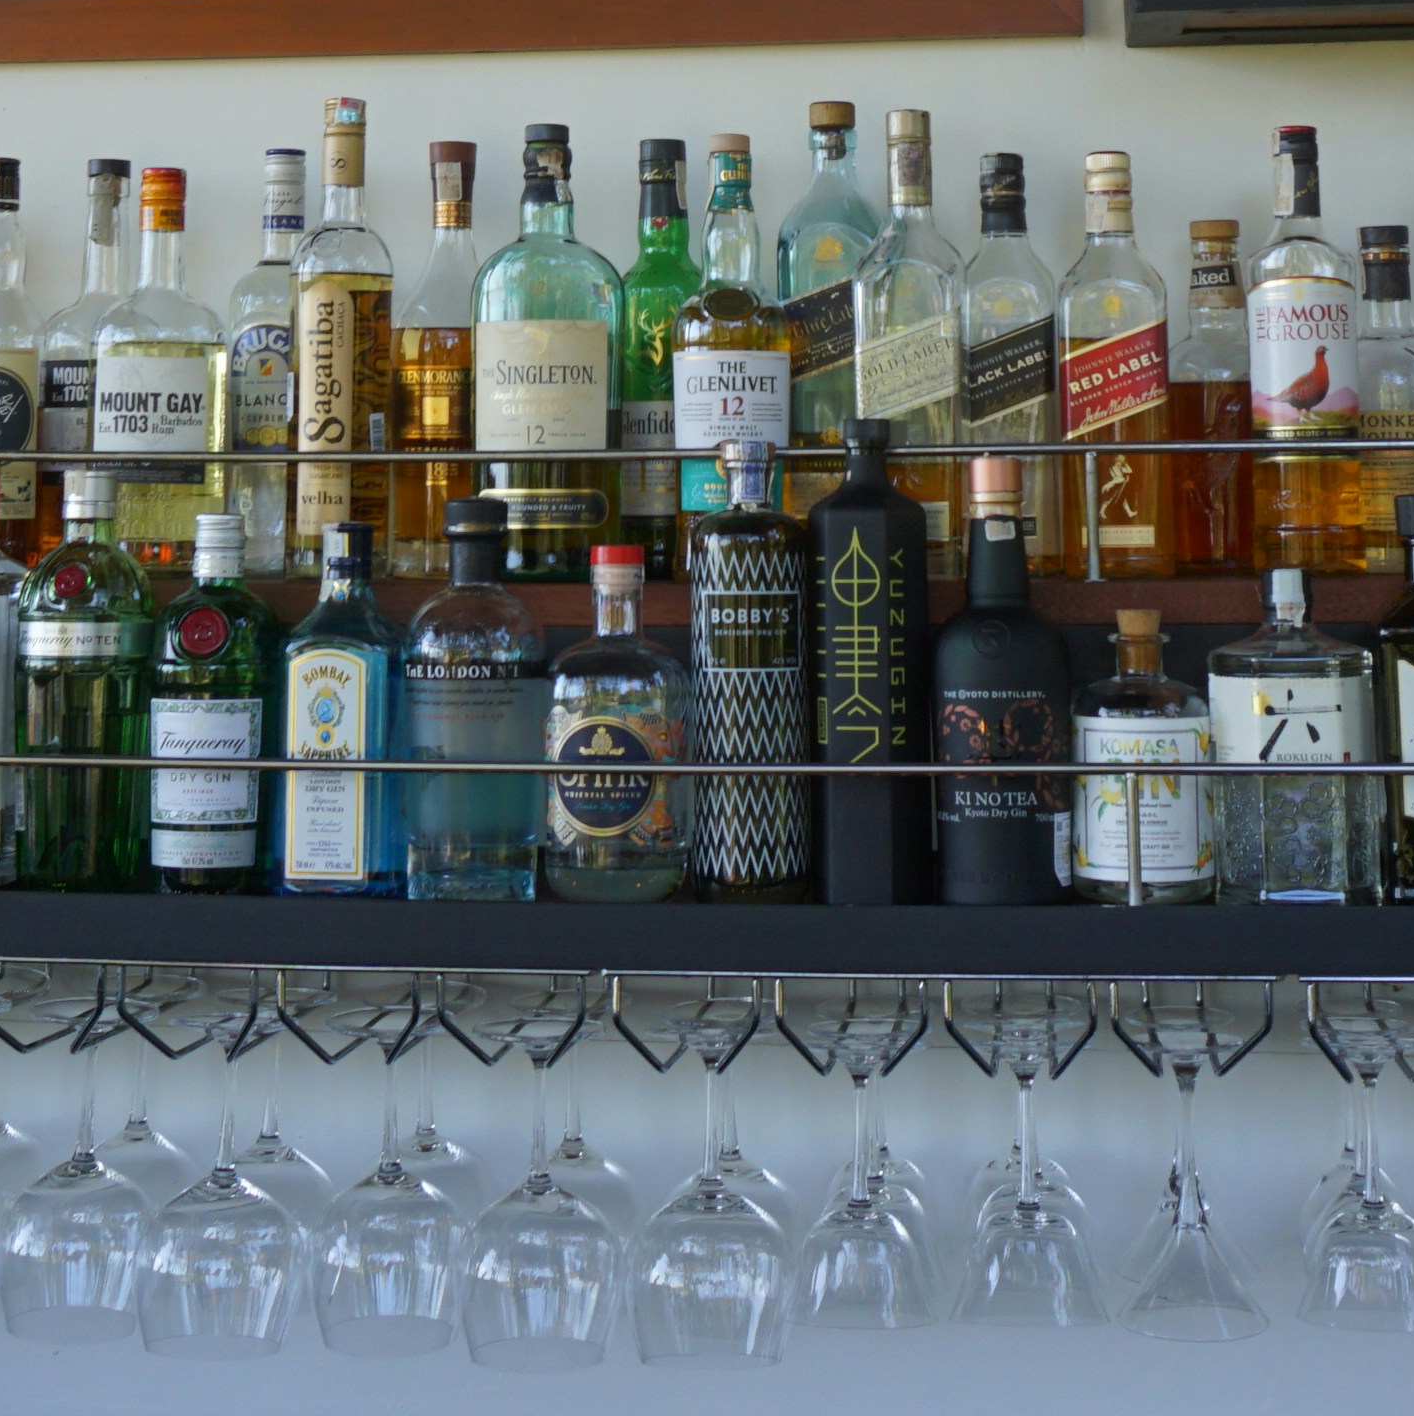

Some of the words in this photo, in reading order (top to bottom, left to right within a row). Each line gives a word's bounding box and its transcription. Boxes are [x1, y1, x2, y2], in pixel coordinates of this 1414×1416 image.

[1266, 304, 1349, 324] FAMOUS
[1267, 323, 1349, 341] GROUSE
[305, 300, 345, 444] Sagatiba
[496, 360, 595, 386] SINGLETON
[717, 361, 747, 374] THE
[1069, 371, 1103, 395] RED
[1106, 350, 1162, 379] LABEL
[686, 375, 777, 395] GLENLIVET
[100, 392, 166, 415] MOUNT
[168, 391, 204, 413] GAY
[720, 396, 744, 417] 12
[113, 415, 148, 434] 1703
[526, 425, 546, 445] 12
[301, 491, 344, 506] velha
[301, 665, 353, 690] BOMBAY
[159, 731, 247, 756] Tanqueray
[1099, 737, 1179, 756] KOMASA
[1310, 752, 1332, 762] GIN
[170, 772, 198, 784] DRY
[204, 772, 232, 783] GIN
[955, 791, 972, 805] KI
[975, 790, 1000, 807] NO
[1004, 790, 1038, 806] TEA
[965, 808, 989, 819] Kyoto
[991, 808, 1008, 819] Dry
[1010, 807, 1027, 818] Gin
